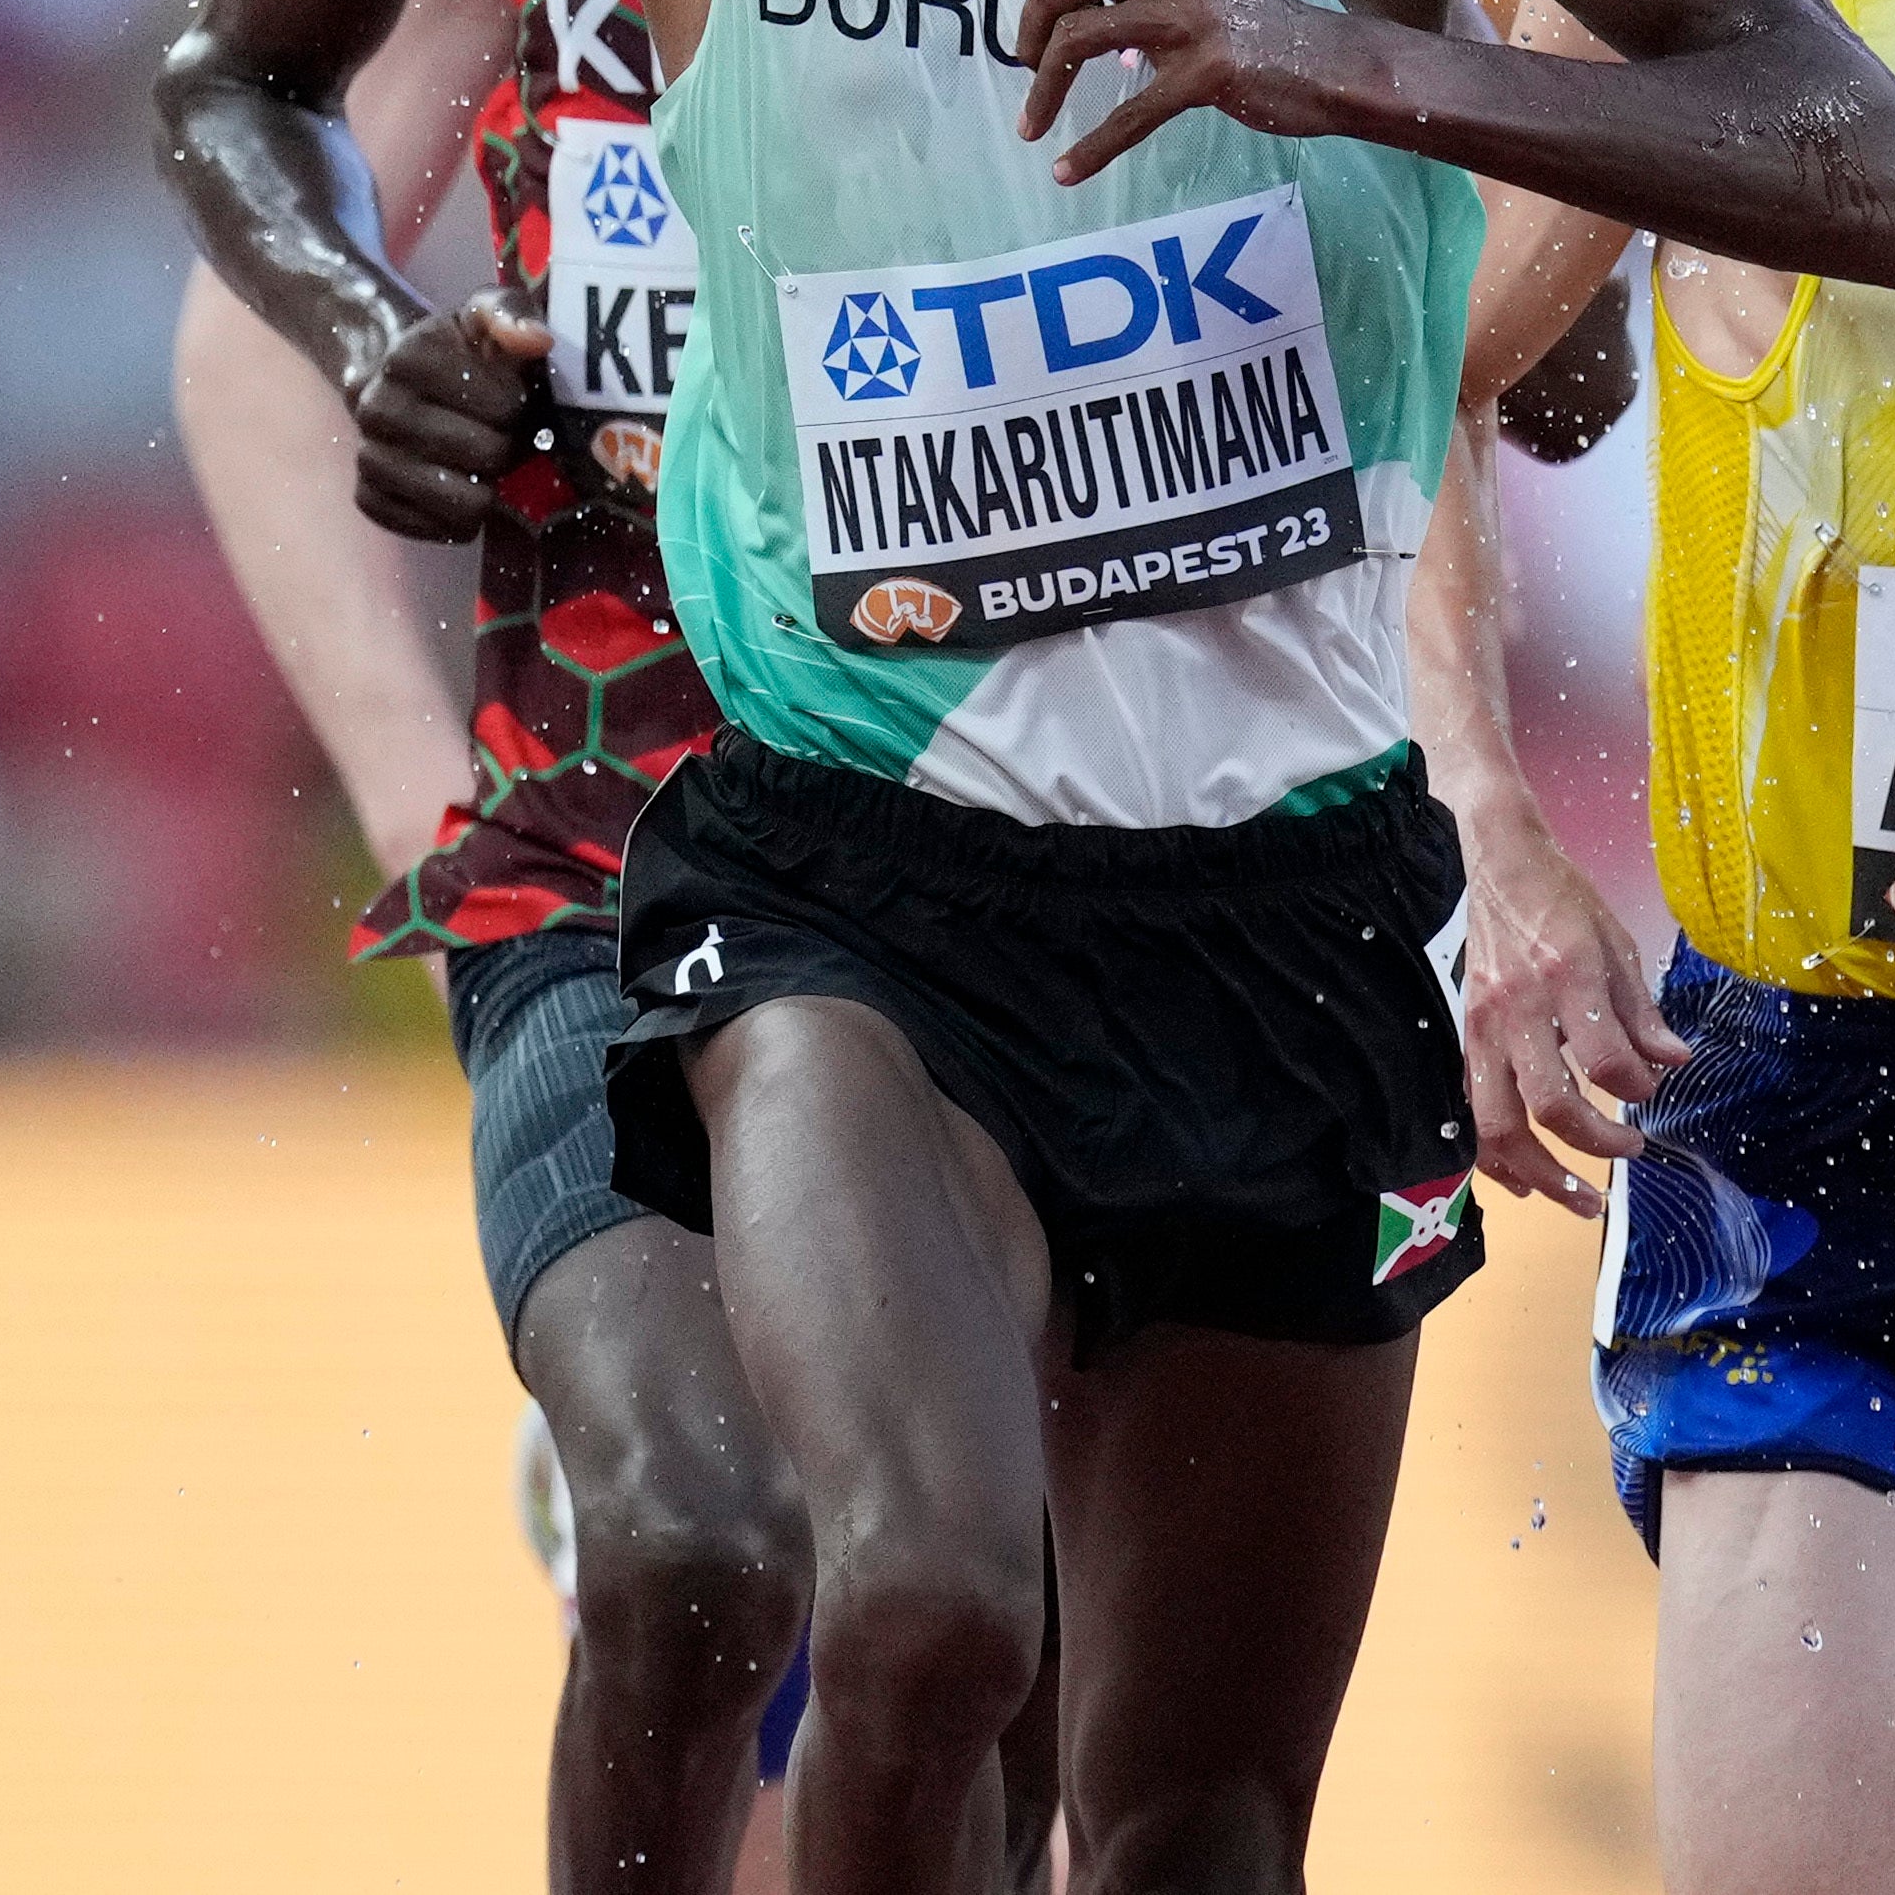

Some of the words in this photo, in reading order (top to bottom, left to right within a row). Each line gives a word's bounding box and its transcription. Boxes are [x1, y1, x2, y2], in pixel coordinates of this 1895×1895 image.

[585, 285, 696, 397] KE
[912, 213, 1284, 389] TDK
[816, 346, 1330, 556] NTAKARUTIMANA
